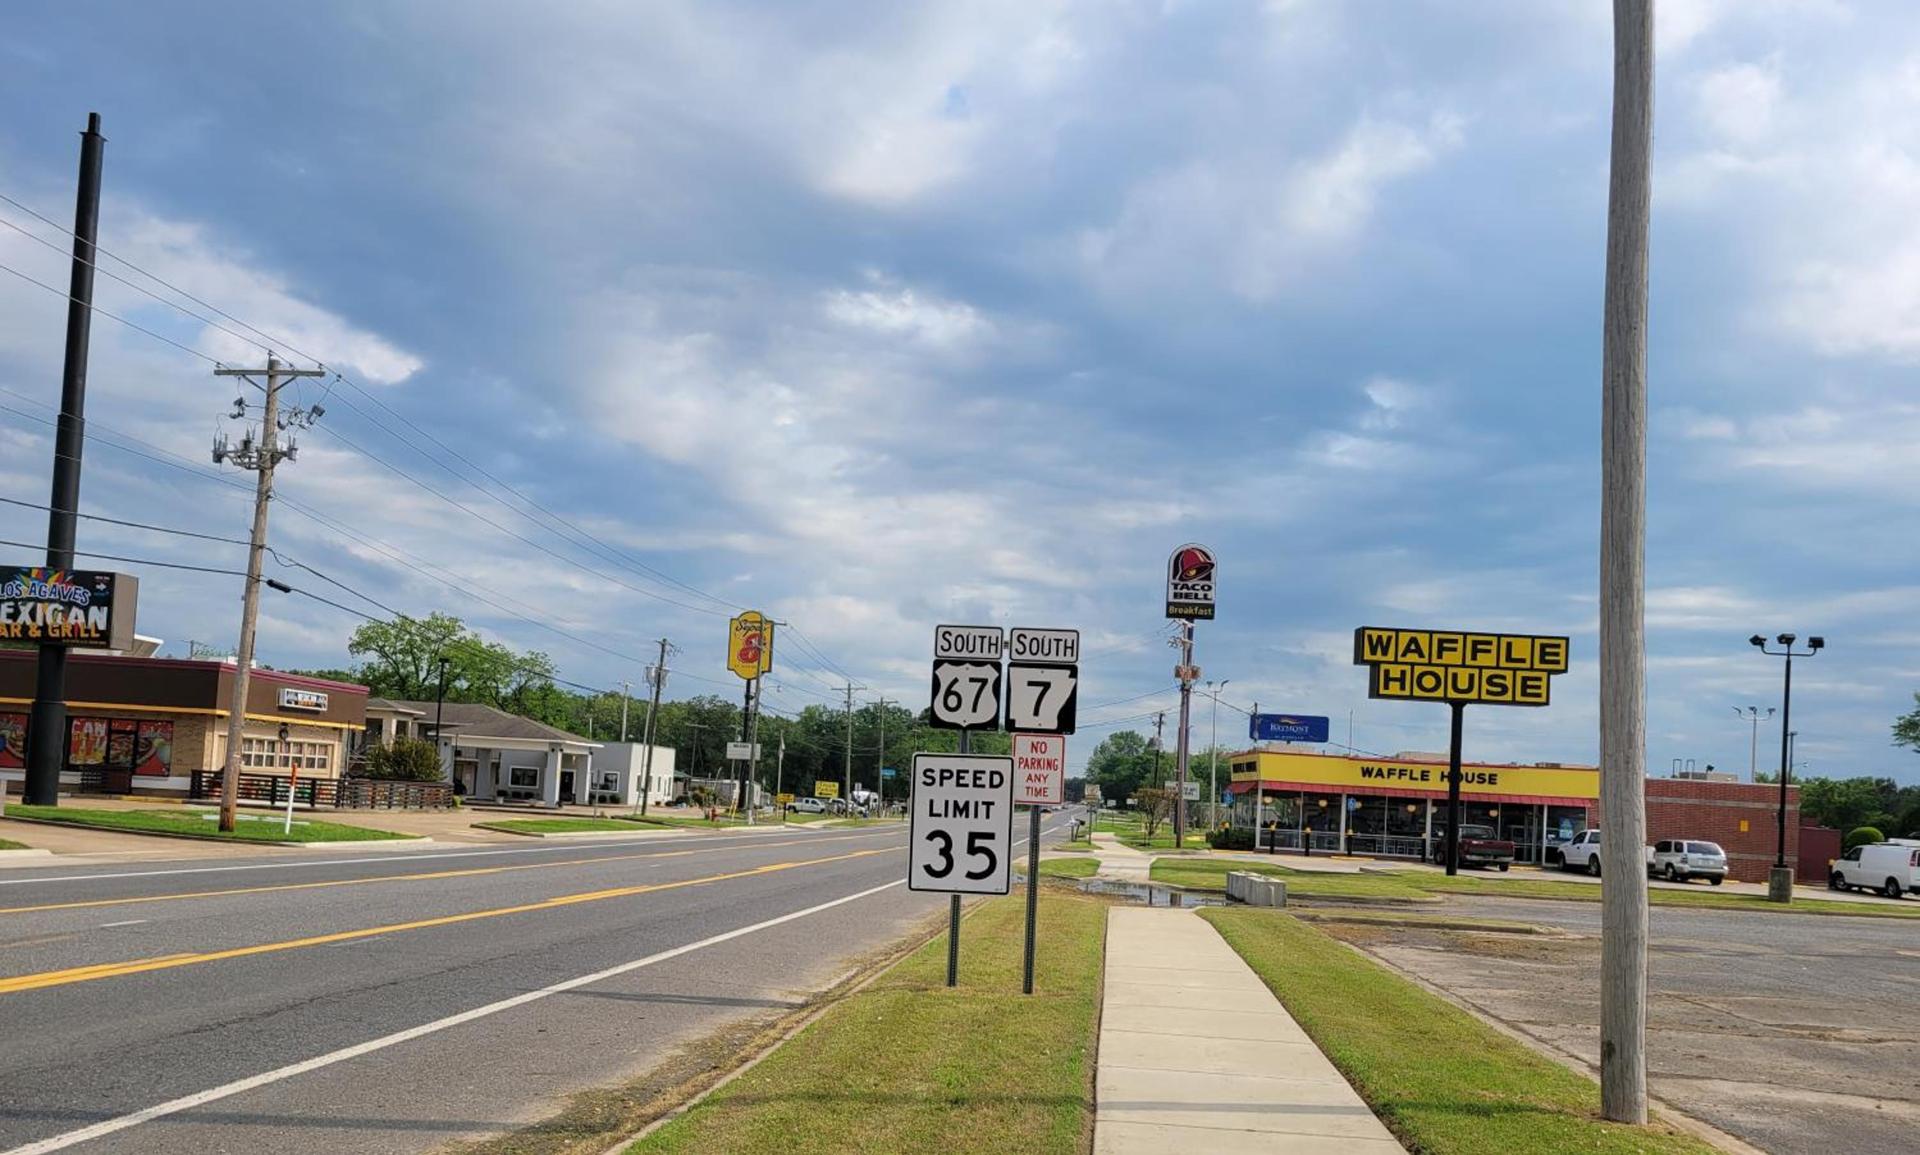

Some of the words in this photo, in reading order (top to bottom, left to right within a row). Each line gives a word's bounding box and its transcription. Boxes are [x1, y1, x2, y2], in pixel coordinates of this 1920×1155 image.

[28, 581, 91, 606] AGAVES
[1171, 582, 1213, 592] TACO
[1173, 591, 1213, 601] BELL
[1168, 606, 1213, 616] Breakfast
[28, 622, 41, 638] &
[940, 630, 999, 655] SOUTH
[1015, 633, 1075, 658] SOUTH
[1366, 634, 1561, 665] WAFFLE
[1383, 669, 1543, 698] HOUSE
[942, 677, 989, 713] 67
[1026, 681, 1052, 717] 7
[1031, 741, 1048, 754] NO
[1018, 757, 1059, 771] PARKING
[922, 768, 1005, 789] SPEED
[1025, 773, 1049, 783] ANY
[1361, 766, 1431, 781] WAFFLE
[1440, 771, 1498, 785] HUSE
[1025, 786, 1049, 797] TIME
[928, 798, 995, 820] LIMIT
[923, 829, 997, 881] 35
